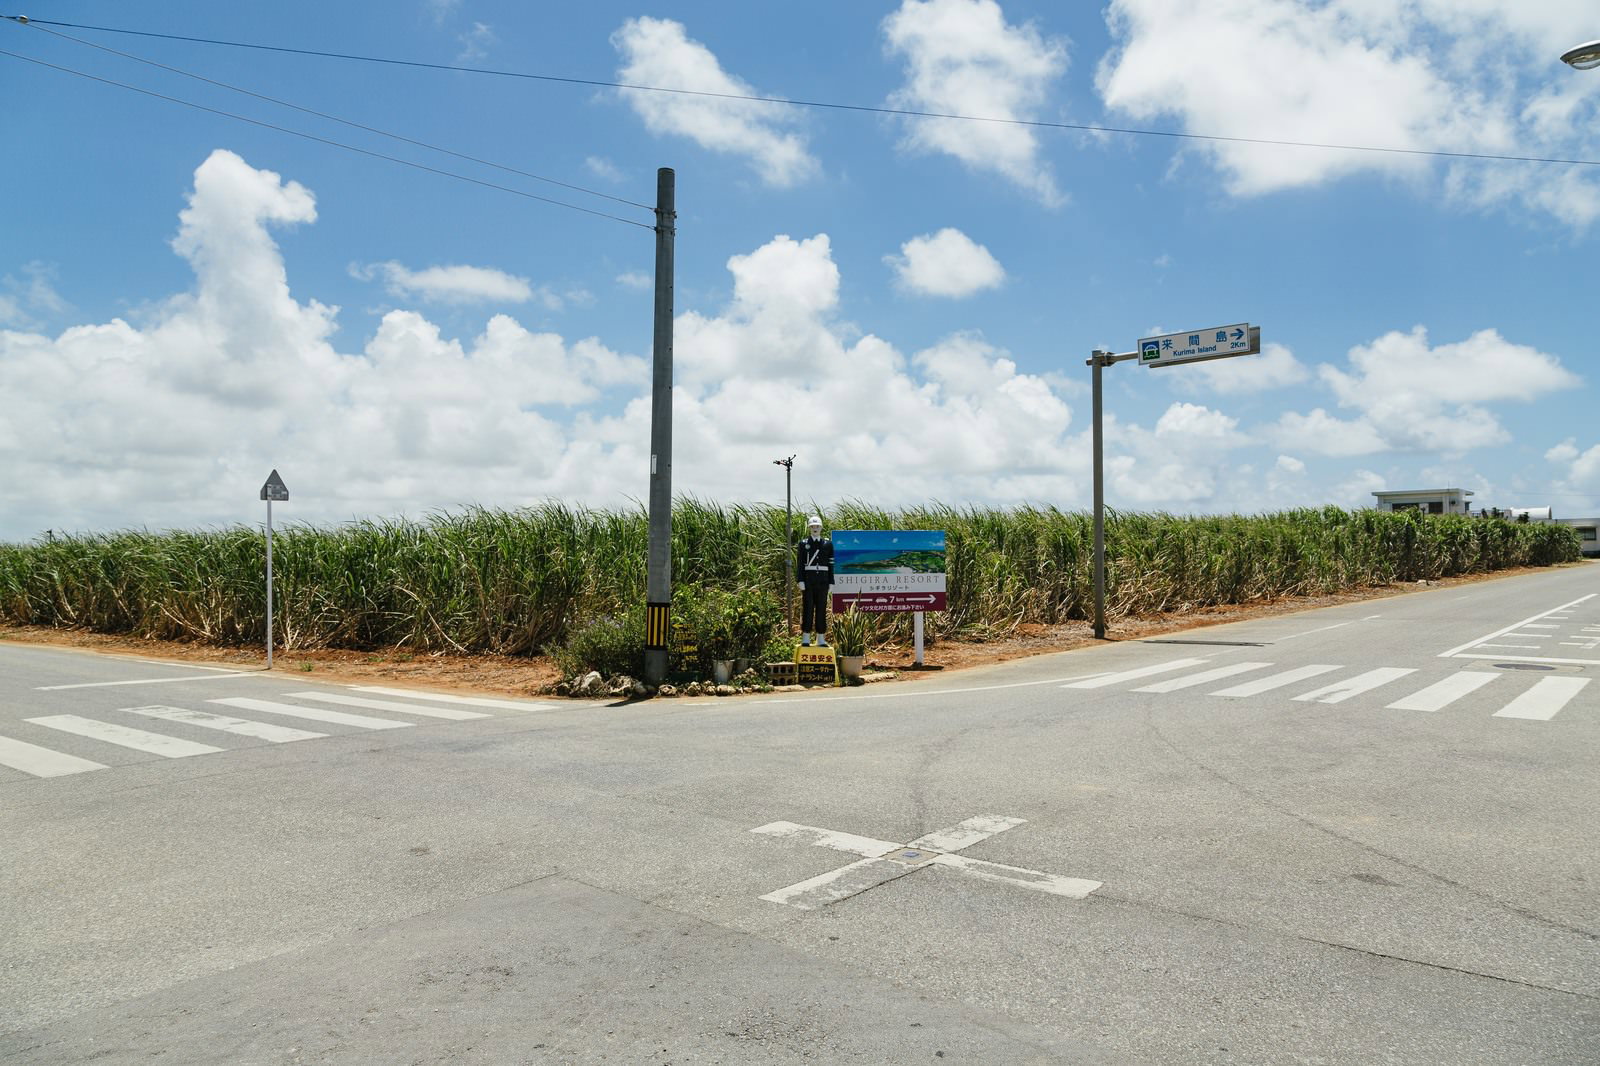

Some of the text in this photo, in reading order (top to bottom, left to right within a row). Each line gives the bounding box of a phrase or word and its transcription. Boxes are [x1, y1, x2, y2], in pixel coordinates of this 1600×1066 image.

[1161, 330, 1228, 350] 来間島
[1230, 340, 1246, 349] 2Km
[1173, 344, 1217, 357] Kurima Island
[839, 575, 940, 584] SHIGIRA RESORT
[889, 595, 895, 604] 7
[801, 653, 833, 663] 交通安全
